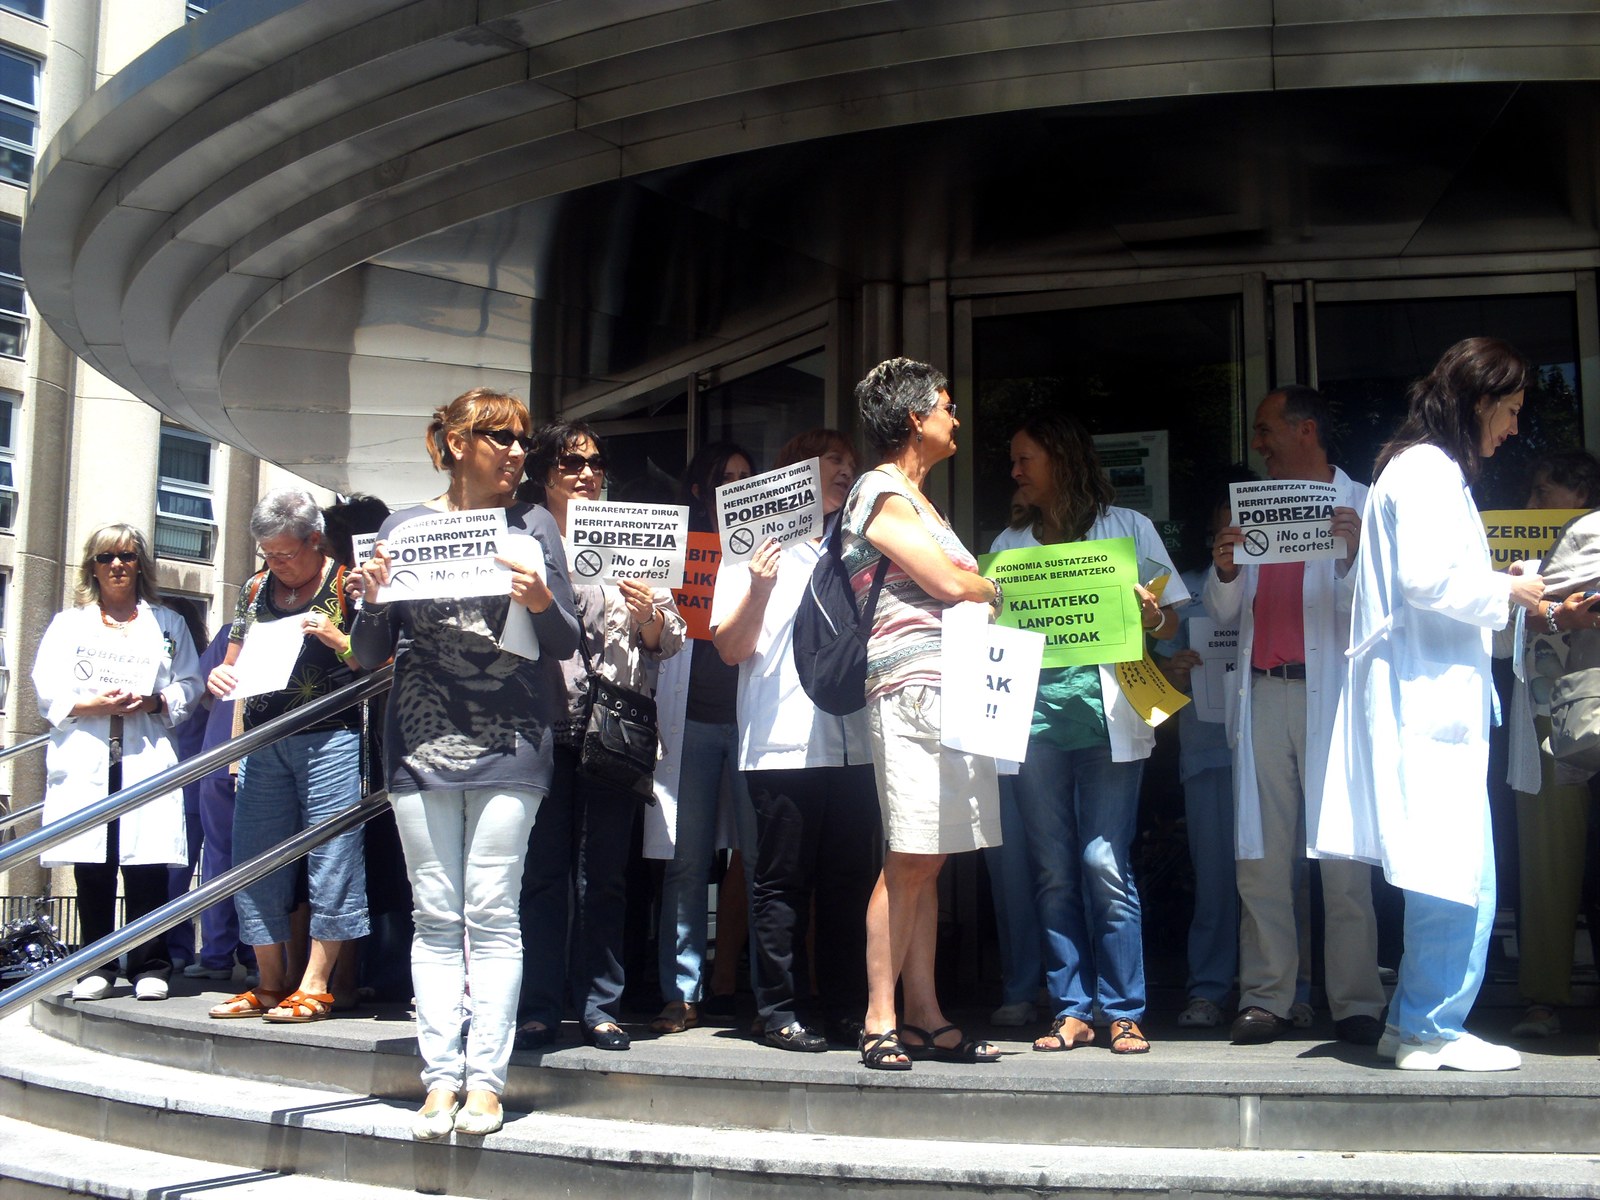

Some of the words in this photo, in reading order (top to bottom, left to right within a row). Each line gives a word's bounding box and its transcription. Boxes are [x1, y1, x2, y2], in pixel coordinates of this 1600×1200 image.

[722, 472, 787, 496] BANKARENTZAT
[788, 464, 811, 477] DIRUA
[723, 477, 813, 510] HERRITARRONTZAT
[1236, 484, 1307, 494] BANKARENTZAT
[1309, 484, 1337, 493] DIRUA
[724, 489, 815, 526] POBREZIA
[1238, 495, 1336, 508] HERRITARRONTZAT
[465, 513, 497, 524] DIRUA
[575, 504, 649, 515] BANKARENTZAT
[651, 509, 679, 517] DIRUA
[1238, 504, 1335, 525] POBREZIA
[574, 518, 679, 531] HERRITARRONTZAT
[761, 521, 784, 535] ¡No
[788, 520, 796, 529] a
[798, 514, 813, 525] los
[573, 529, 677, 548] POBREZIA
[770, 523, 813, 545] ecortes!
[1276, 530, 1299, 542] ¡No
[1302, 532, 1311, 540] a
[1315, 527, 1333, 538] los
[1279, 538, 1334, 554] recortes!
[611, 554, 635, 566] ¡No
[639, 559, 648, 567] a
[652, 556, 671, 568] los
[995, 561, 1043, 573] EKONOMIA
[1044, 554, 1108, 568] SUSTATZEKO
[612, 568, 669, 579] recortes!
[683, 571, 717, 586] LIK
[995, 573, 1048, 585] SKUBIDEAK
[1049, 566, 1116, 580] BERMATZEKO
[1009, 593, 1100, 612] KALITATEKO
[1018, 613, 1095, 630] LANPOSTU
[1044, 631, 1100, 646] LIKOAK
